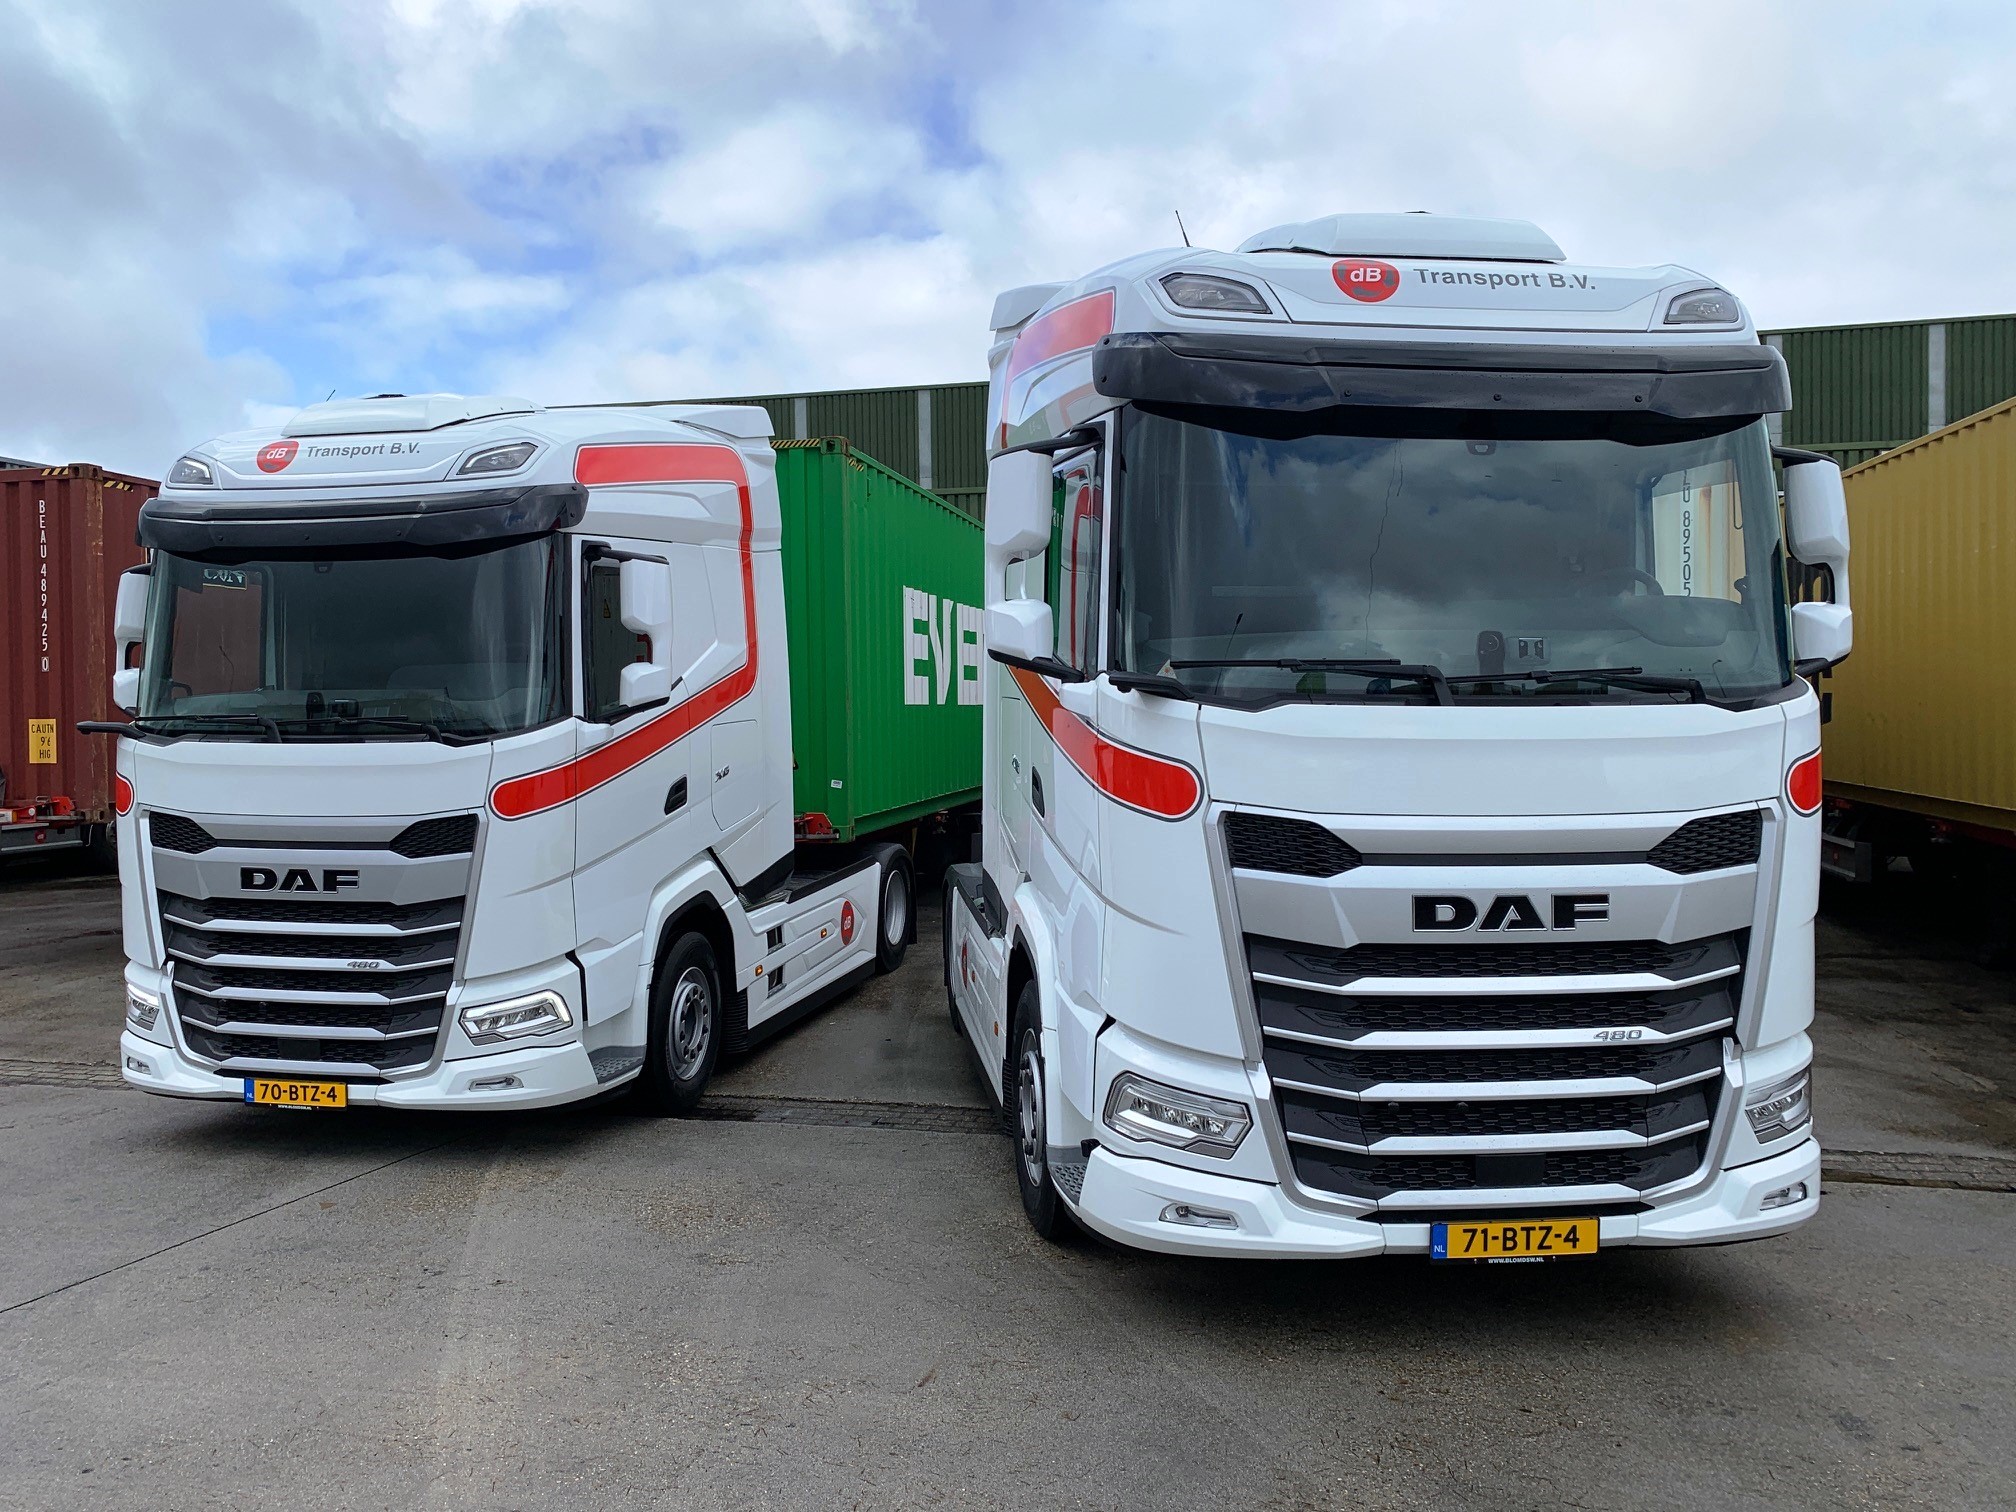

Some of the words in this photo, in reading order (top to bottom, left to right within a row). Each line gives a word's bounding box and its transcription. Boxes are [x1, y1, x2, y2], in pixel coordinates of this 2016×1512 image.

[1349, 267, 1382, 283] dB
[1413, 268, 1542, 290] Transport
[1549, 272, 1597, 290] B.V.
[266, 447, 289, 460] dB
[306, 443, 385, 459] Transport
[390, 441, 421, 455] B.V.
[38, 500, 48, 559] BEAU
[40, 563, 49, 652] 489425
[240, 865, 360, 895] DAF
[1412, 893, 1610, 932] DAF
[347, 960, 381, 970] 480
[1593, 1029, 1643, 1042] 480
[259, 1083, 338, 1103] 70-BTZ-4
[1433, 1244, 1446, 1253] NL
[1462, 1224, 1580, 1253] 71-BTZ-4
